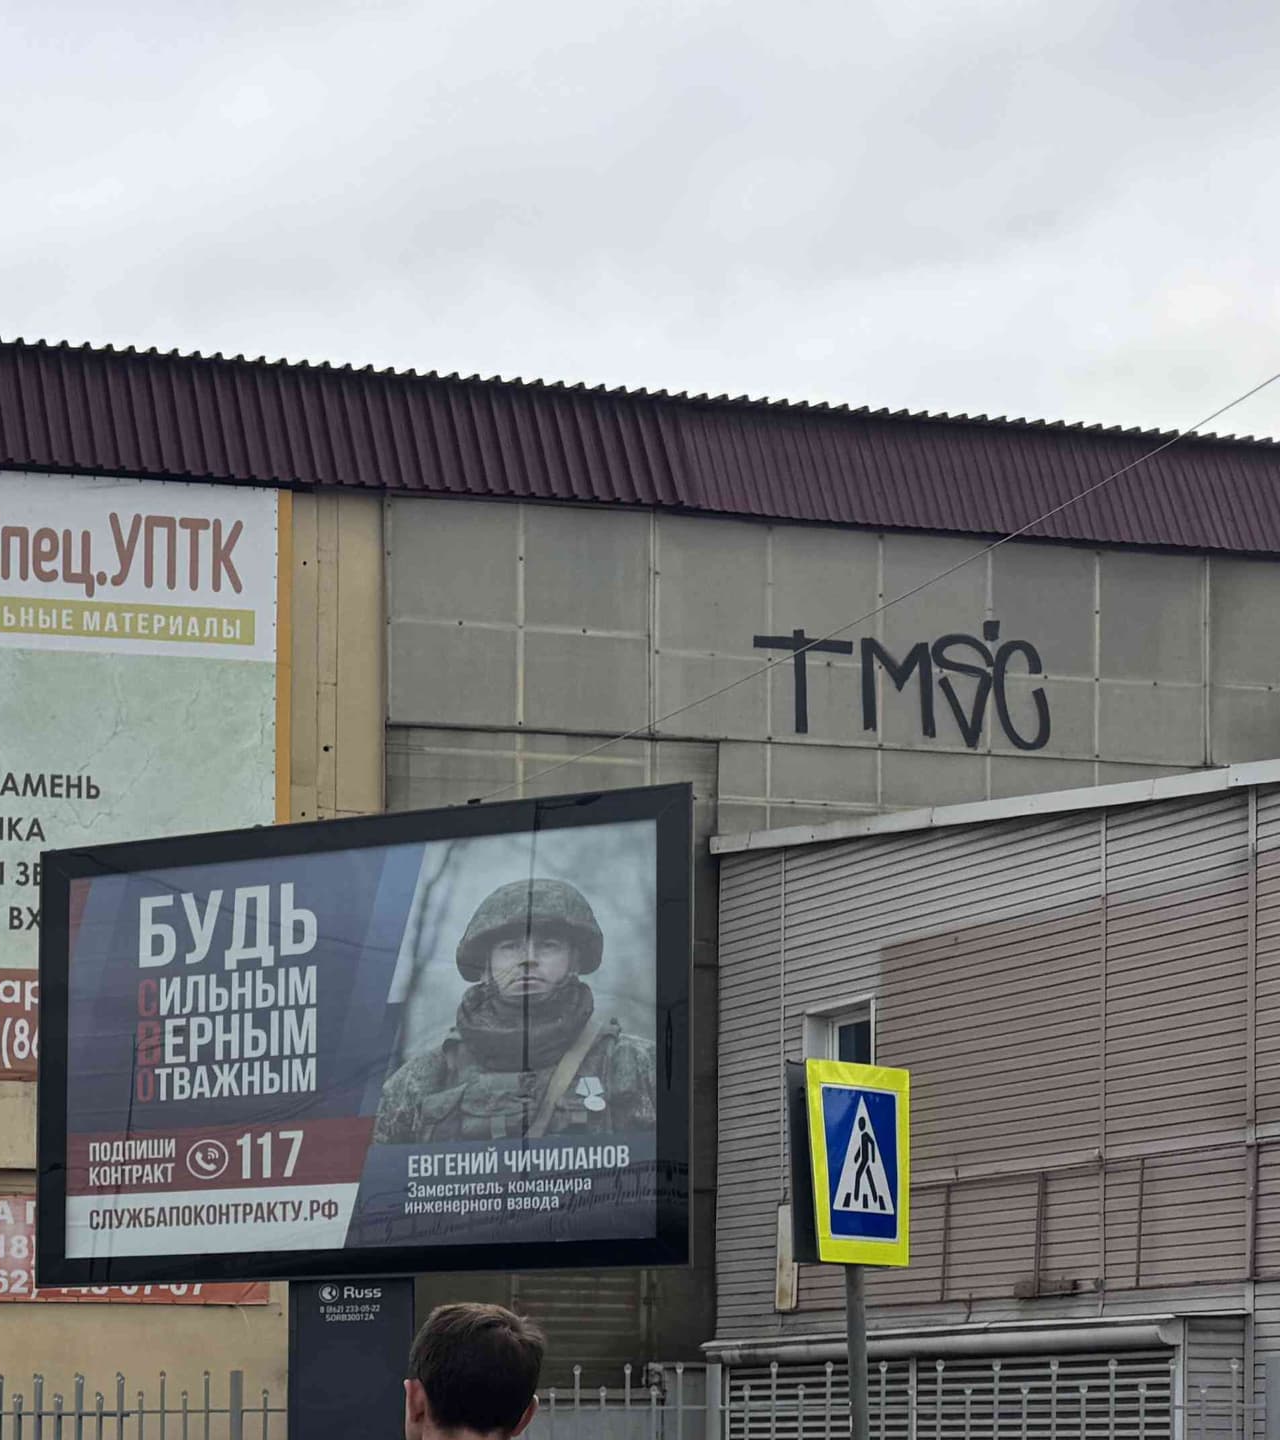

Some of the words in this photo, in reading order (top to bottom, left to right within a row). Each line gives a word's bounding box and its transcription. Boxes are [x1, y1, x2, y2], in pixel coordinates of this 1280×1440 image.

[81, 606, 242, 640] МАТЕРИАЛЫ
[139, 882, 318, 970] БУДЬ
[139, 965, 318, 1017] СИЛЬНЫМ
[138, 1007, 317, 1067] ВЕРНЫМ
[137, 1057, 317, 1104] ОТВАЖНЫМ
[89, 1138, 176, 1164] ПОДПИШИ
[236, 1130, 304, 1180] 117
[408, 1147, 498, 1178] ЕВГЕНИЙ
[504, 1145, 630, 1174] ЧИЧИЛАНОВ
[89, 1163, 176, 1187] КОНТРАКТ
[408, 1179, 503, 1198] Заместитель
[508, 1177, 592, 1195] командира
[89, 1199, 339, 1231] СЛУЖБАПОКОНТРАКТУ.РФ
[405, 1198, 502, 1216] инженерного
[507, 1195, 559, 1211] взвода
[343, 1286, 382, 1299] Russ
